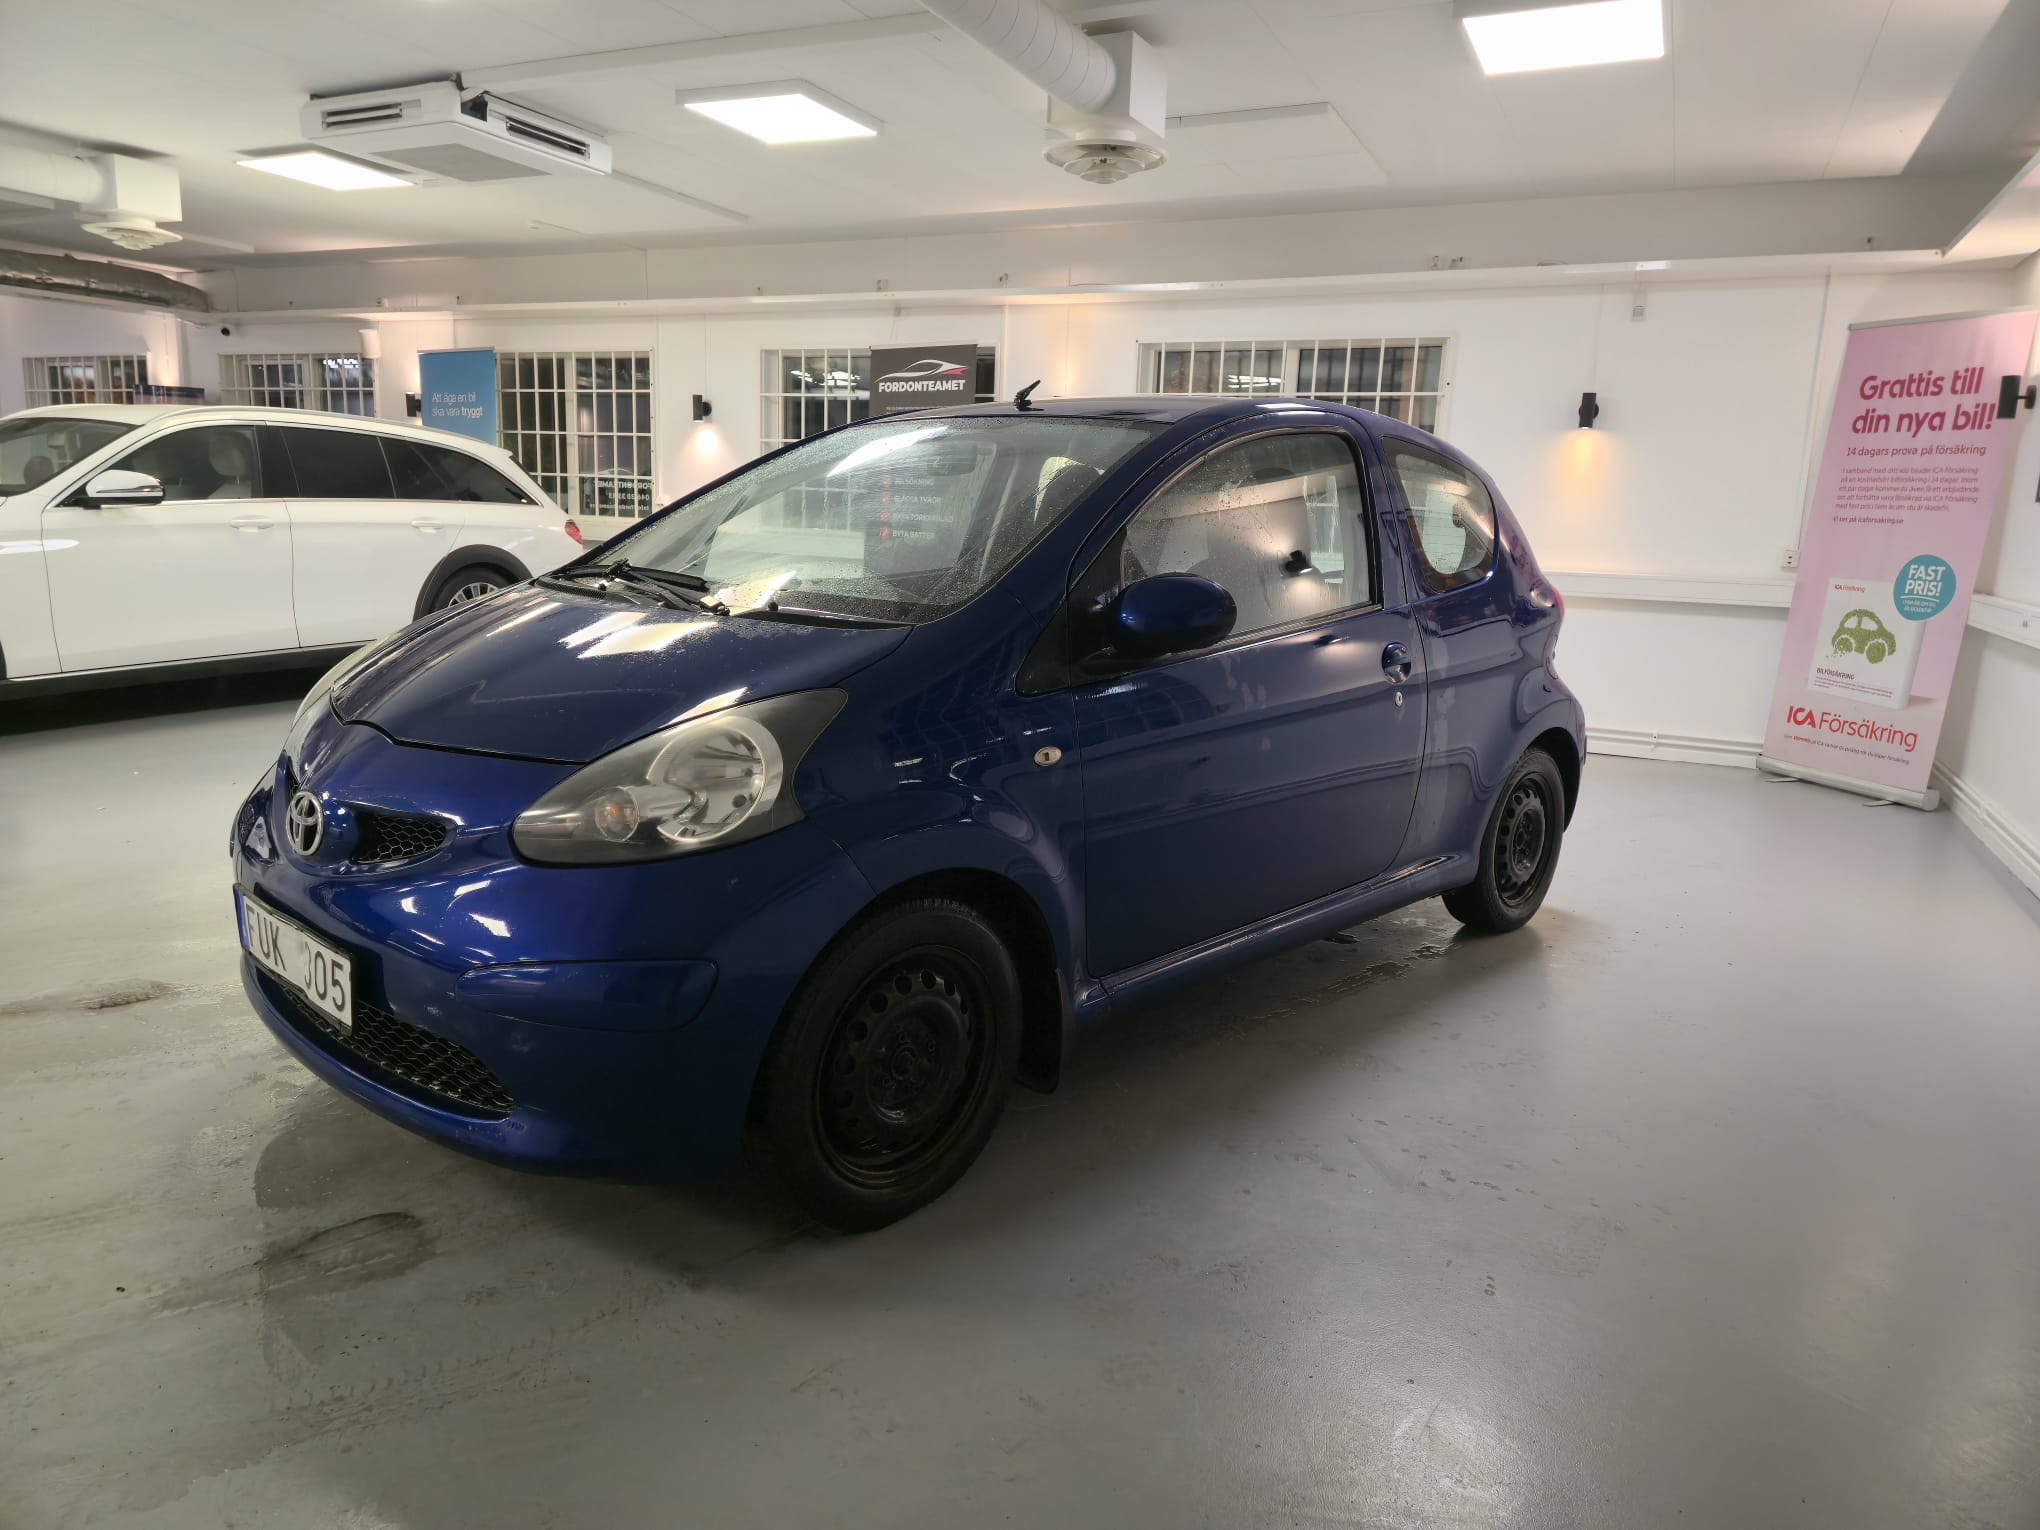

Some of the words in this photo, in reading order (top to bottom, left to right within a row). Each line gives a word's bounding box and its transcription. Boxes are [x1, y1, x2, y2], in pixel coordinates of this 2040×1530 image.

[878, 379, 966, 393] FORDONTEAMET
[1859, 370, 1947, 400] Grattis
[1950, 366, 1985, 395] till
[457, 394, 467, 402] en
[462, 405, 483, 419] tryggt
[1852, 408, 1891, 434] din
[1895, 410, 1947, 438] nya
[1951, 402, 1996, 432] bil!
[1846, 447, 1857, 457] 14
[1858, 446, 1890, 458] dagars
[1890, 447, 1918, 457] prova
[1920, 445, 1934, 457] på
[1935, 444, 1987, 457] försäkring
[1908, 564, 1946, 581] FAST
[1904, 580, 1942, 597] PRIS!
[1786, 705, 1817, 729] ICA
[1818, 711, 1919, 752] Försäkring
[246, 903, 287, 972] FUK
